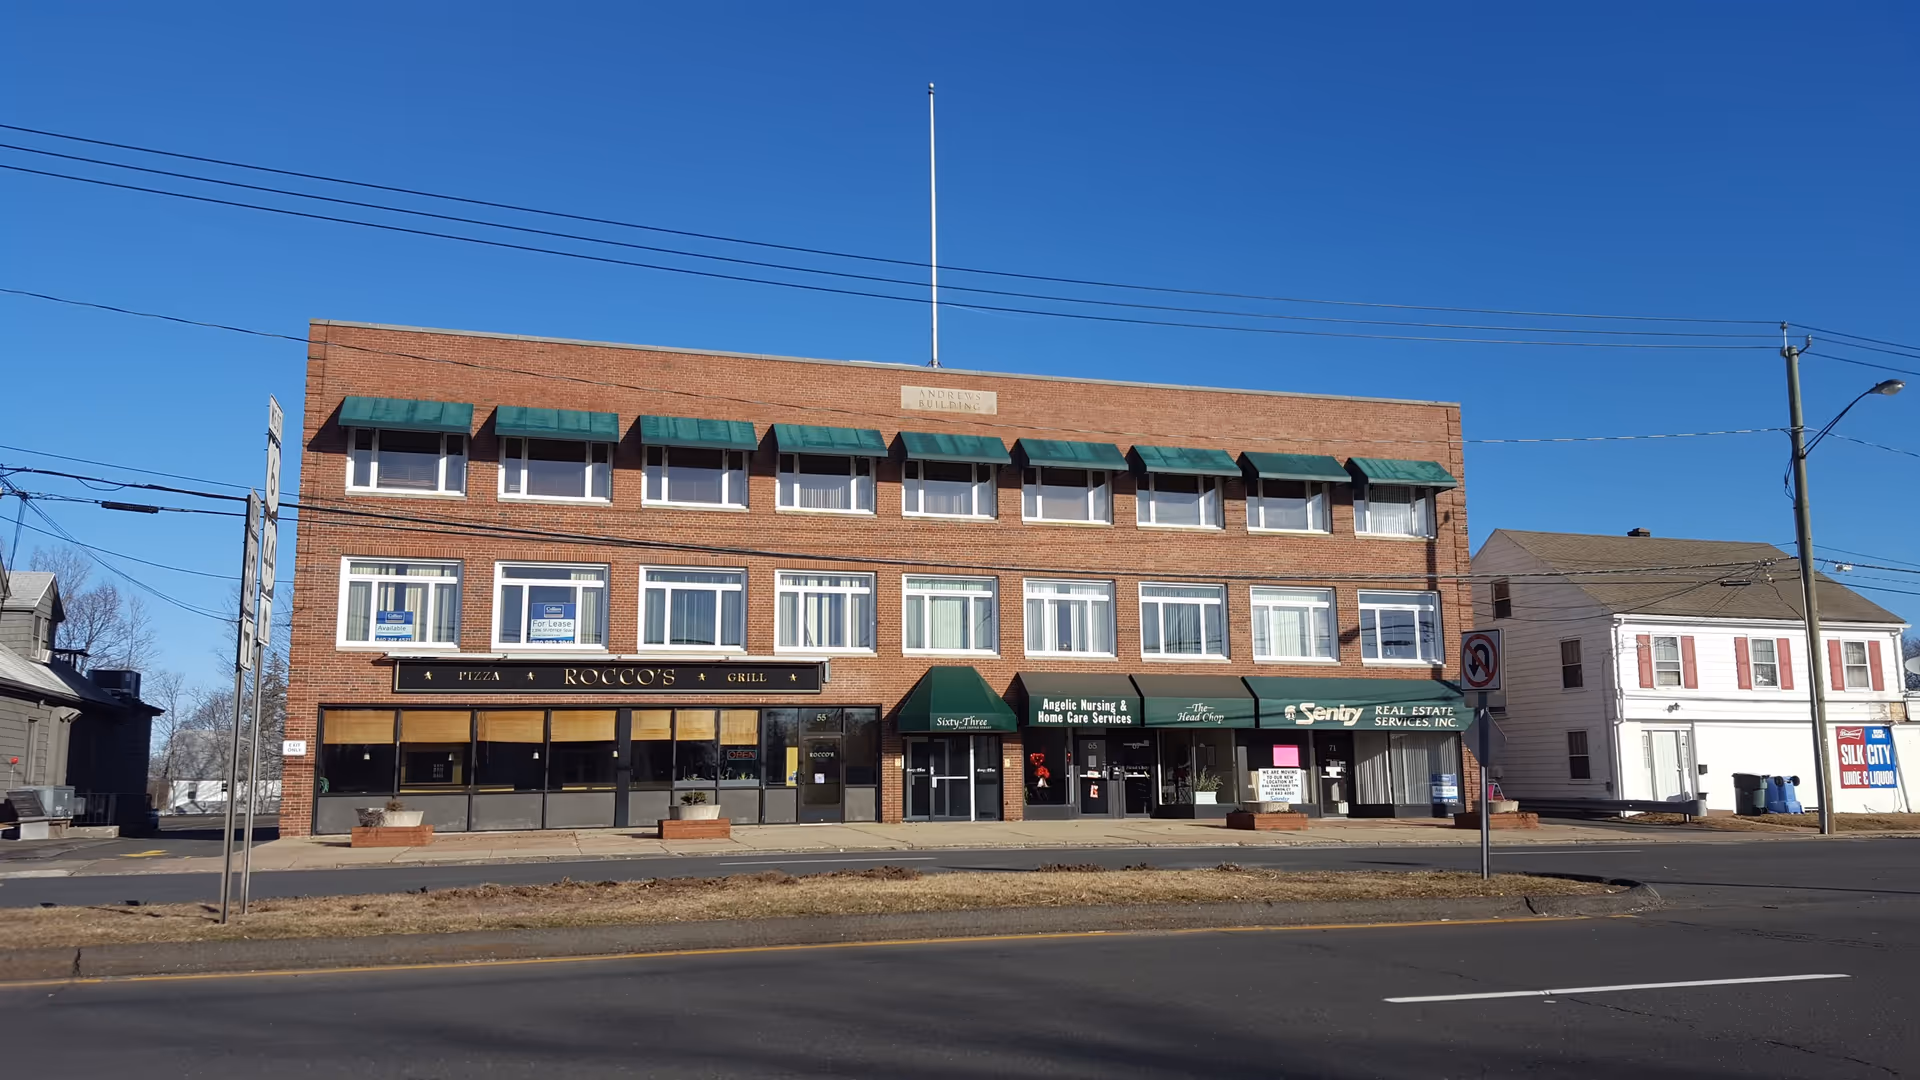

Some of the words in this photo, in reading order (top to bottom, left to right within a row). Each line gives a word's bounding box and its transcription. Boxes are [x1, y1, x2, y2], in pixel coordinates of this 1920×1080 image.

[919, 389, 981, 401] ANDREWS
[918, 399, 981, 411] BUILDING
[270, 457, 276, 497] 6
[263, 535, 275, 579] 44
[458, 671, 500, 681] PIZZA
[563, 668, 676, 686] ROCCO'S
[727, 672, 767, 682] GRILL
[1042, 698, 1077, 712] Angelic
[1081, 699, 1116, 714] Nursing
[1120, 700, 1128, 712] &
[1375, 705, 1406, 716] REAL
[1411, 706, 1454, 716] ESTATE
[816, 713, 827, 722] 55
[1038, 711, 1064, 723] Home
[1067, 712, 1089, 724] Care
[1092, 712, 1132, 724] Services
[1177, 713, 1200, 722] Head
[1202, 713, 1225, 724] Chop
[1296, 702, 1364, 727] Sentry
[936, 715, 988, 730] Sixty-Three
[1374, 717, 1432, 728] SERVICES,
[1434, 717, 1459, 728] INC.
[1087, 742, 1098, 750] 65
[1328, 744, 1337, 752] 71
[728, 751, 756, 759] OPEN
[1840, 744, 1866, 765] SILK
[1866, 744, 1891, 765] CITY
[1842, 771, 1862, 785] WINE
[1869, 771, 1895, 786] LIQUOR
